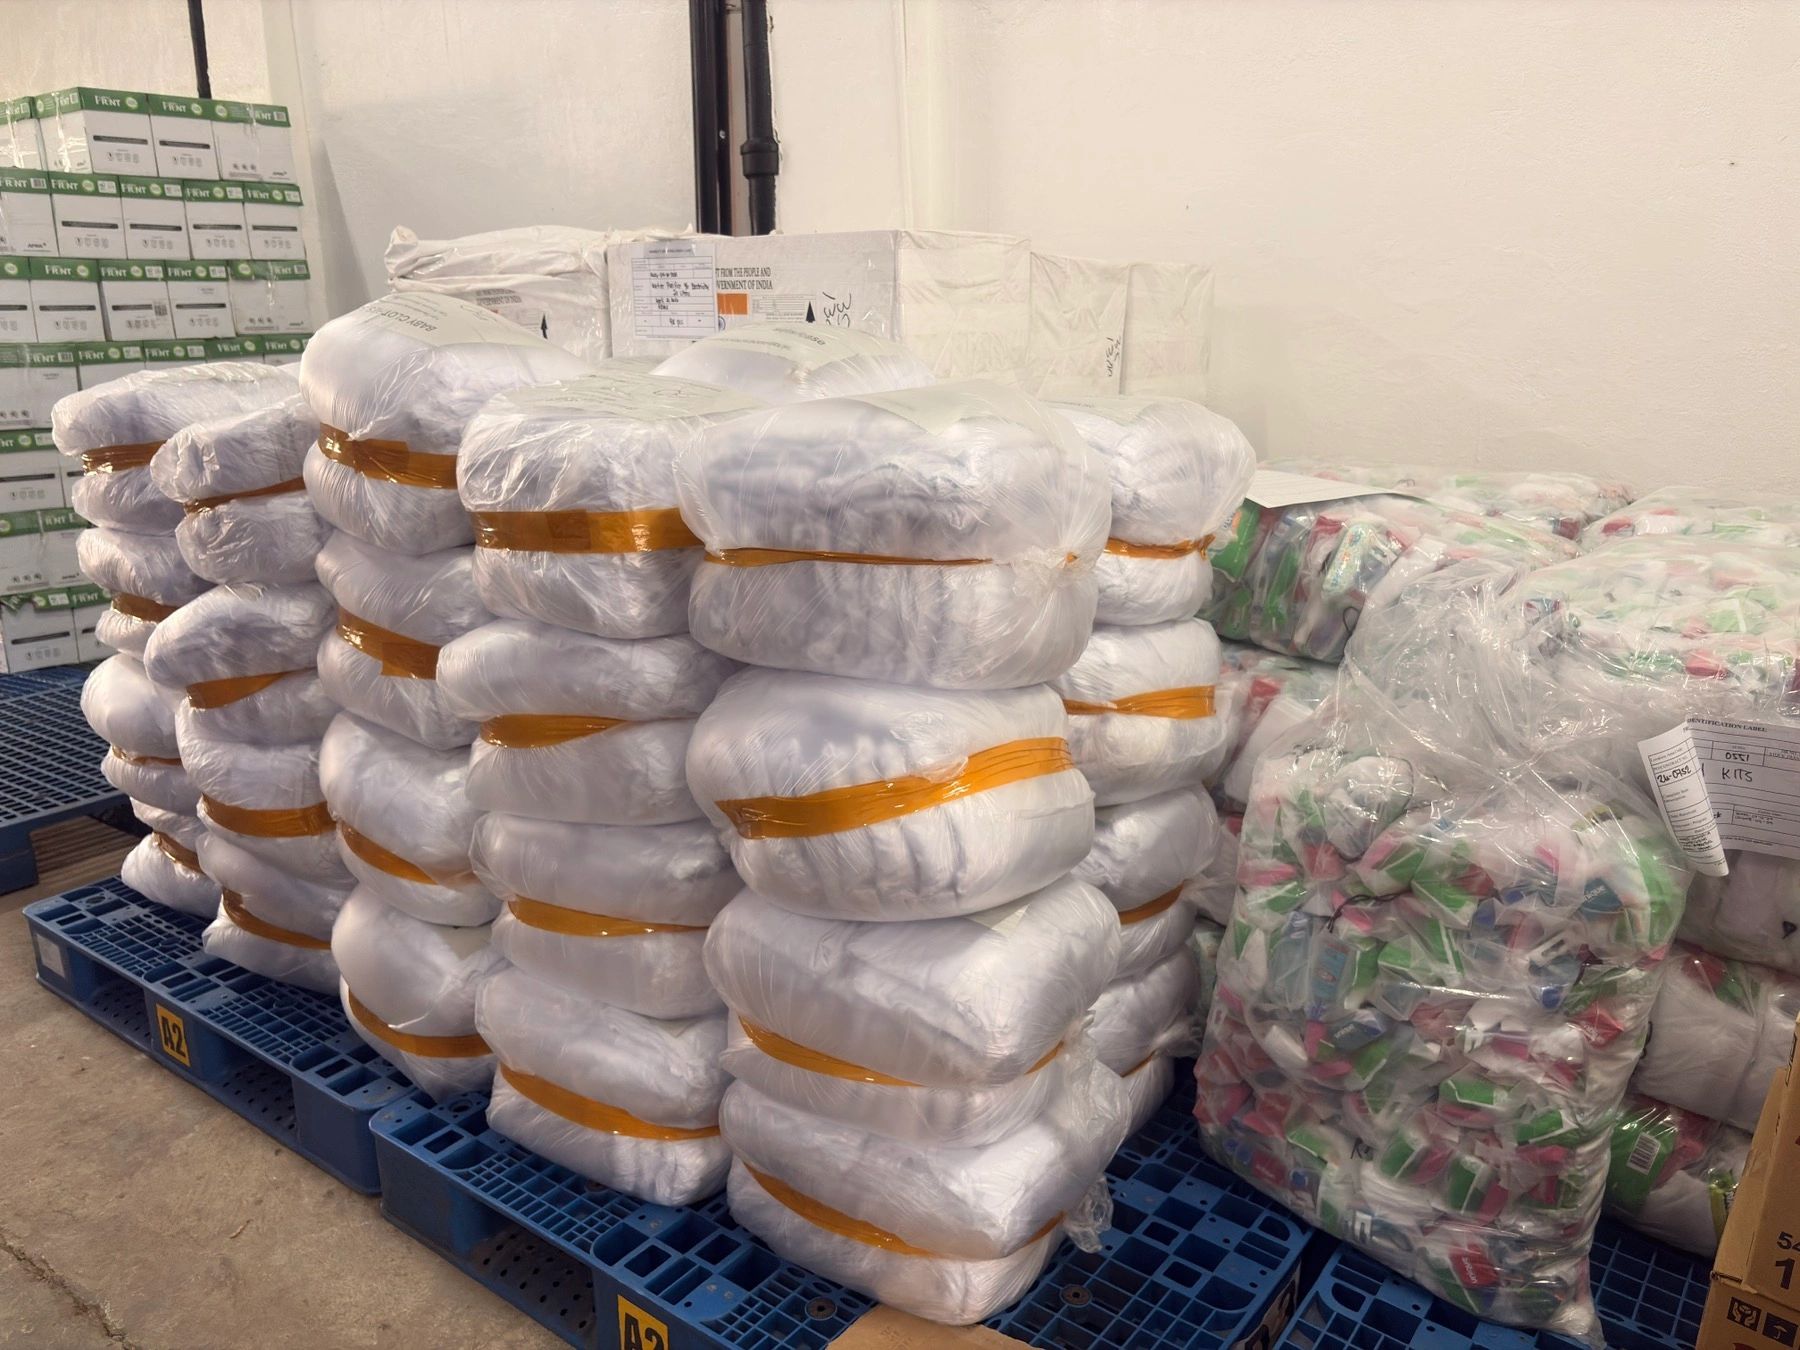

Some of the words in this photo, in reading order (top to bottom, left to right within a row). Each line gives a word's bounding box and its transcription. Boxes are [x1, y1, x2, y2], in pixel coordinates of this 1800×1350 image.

[756, 280, 773, 290] INDIA
[1722, 767, 1753, 783] KITS
[161, 1015, 187, 1058] A2
